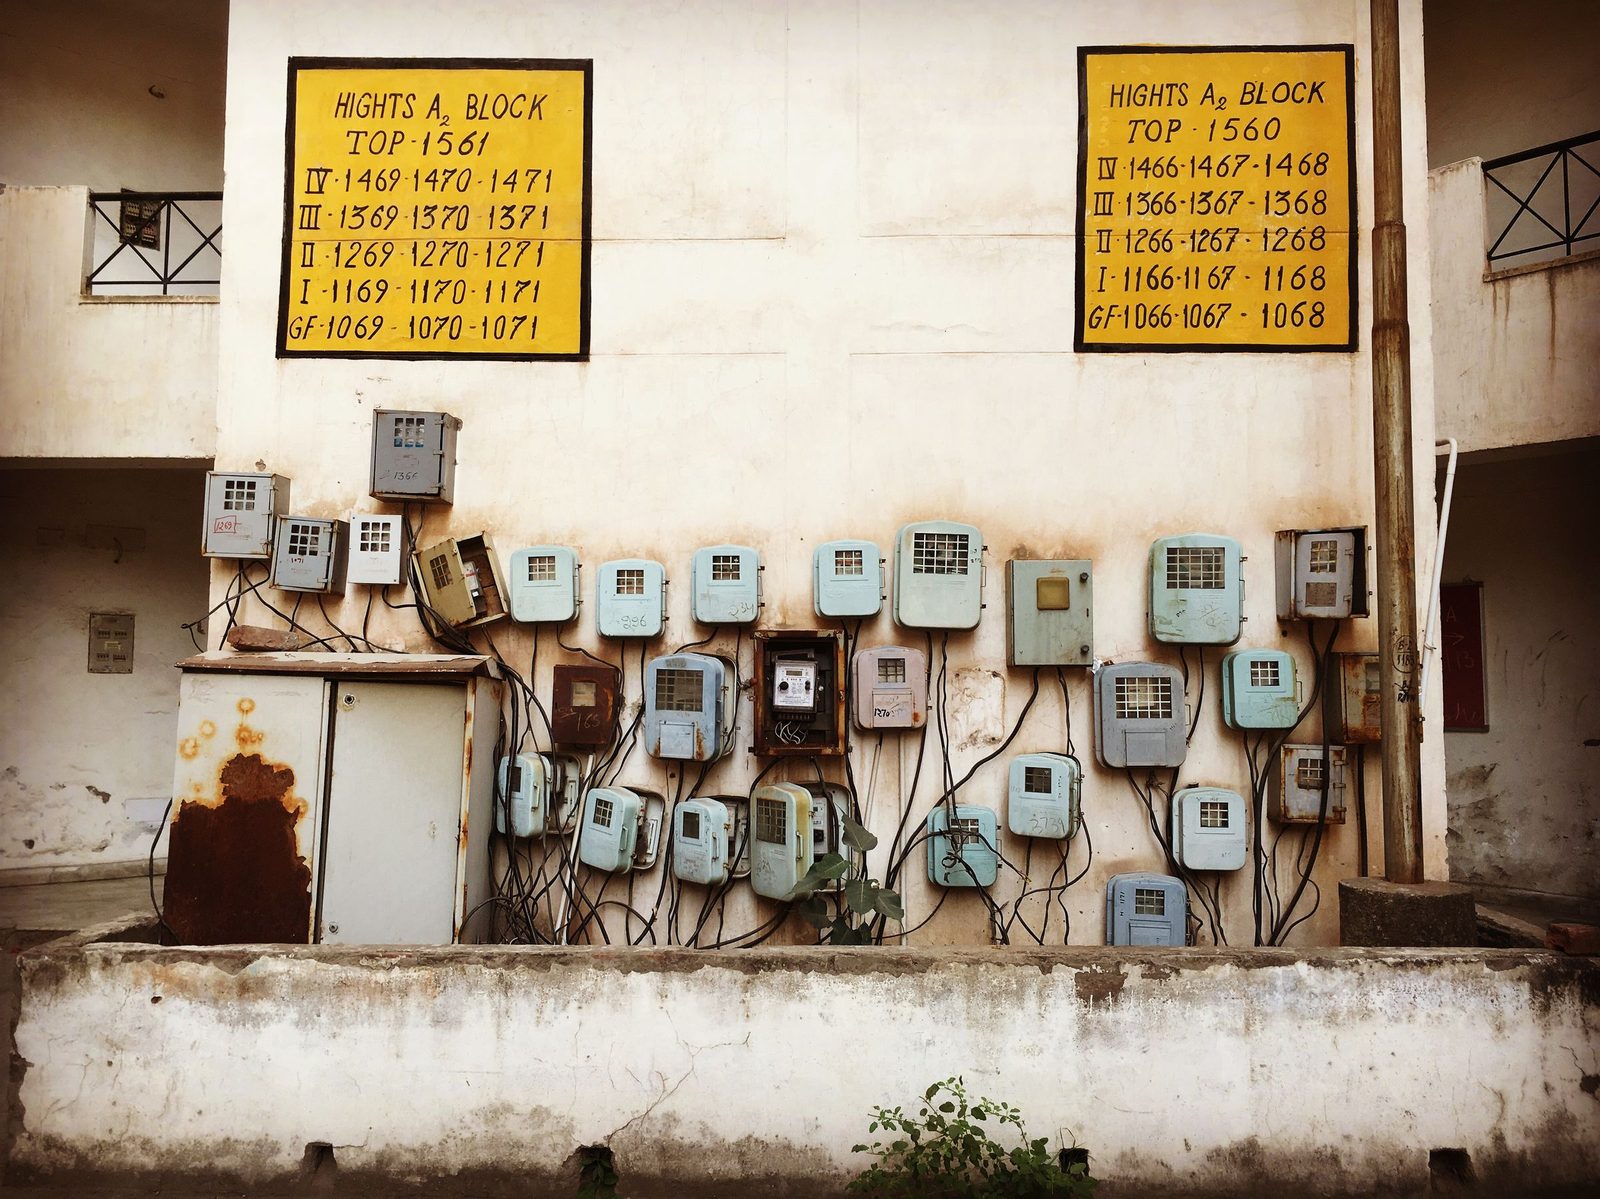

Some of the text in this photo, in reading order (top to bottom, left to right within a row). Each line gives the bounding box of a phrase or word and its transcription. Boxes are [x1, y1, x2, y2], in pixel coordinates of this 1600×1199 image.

[334, 92, 416, 119] HIGHTS
[465, 93, 548, 121] BLOCK
[1110, 82, 1189, 108] HIGHTS
[1239, 81, 1326, 105] BLOCK
